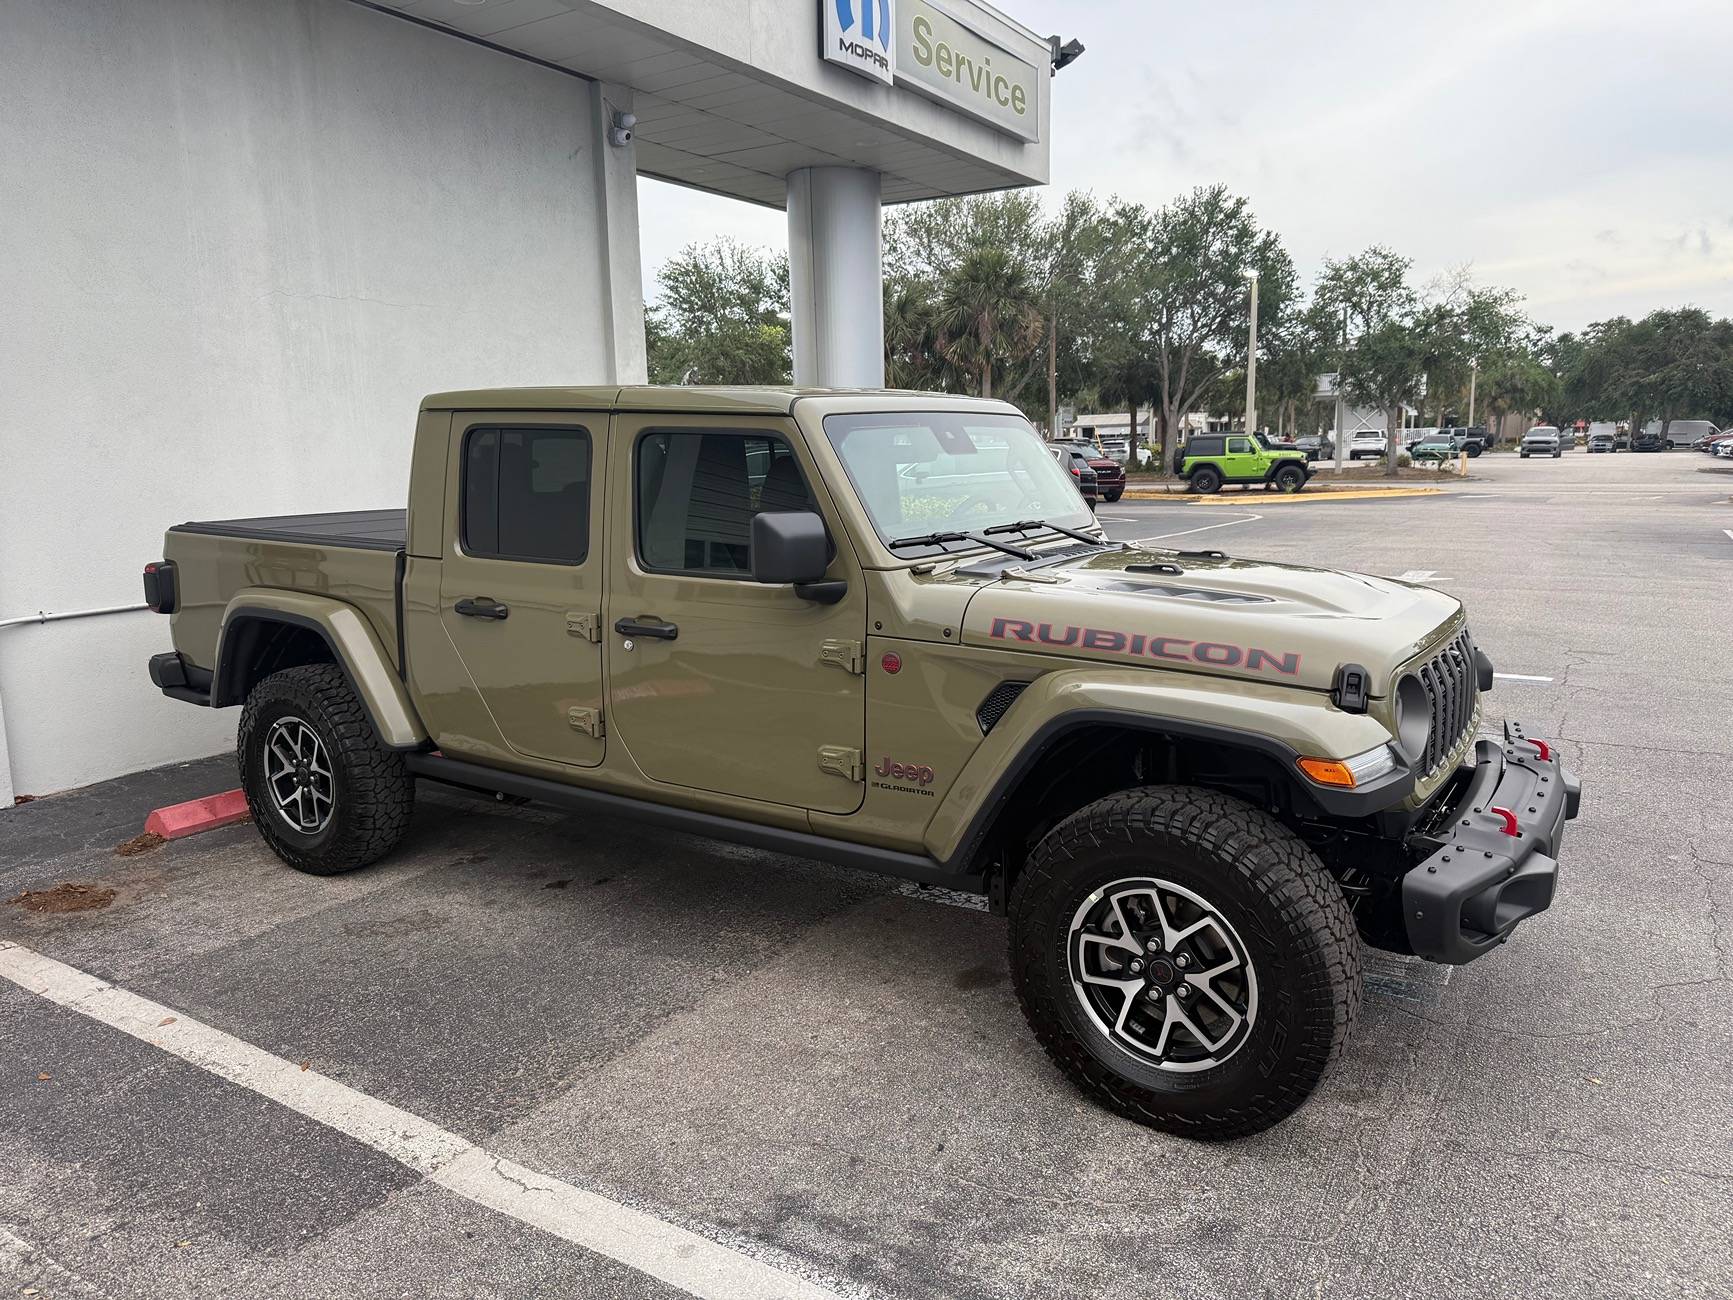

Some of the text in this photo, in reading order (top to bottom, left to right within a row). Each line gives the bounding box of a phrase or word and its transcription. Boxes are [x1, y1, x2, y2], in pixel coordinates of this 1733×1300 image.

[839, 37, 889, 72] MOPAR
[912, 15, 1026, 115] Service
[990, 617, 1302, 676] RUBICON
[874, 756, 934, 787] Jeep
[880, 783, 935, 797] GLADIATOR
